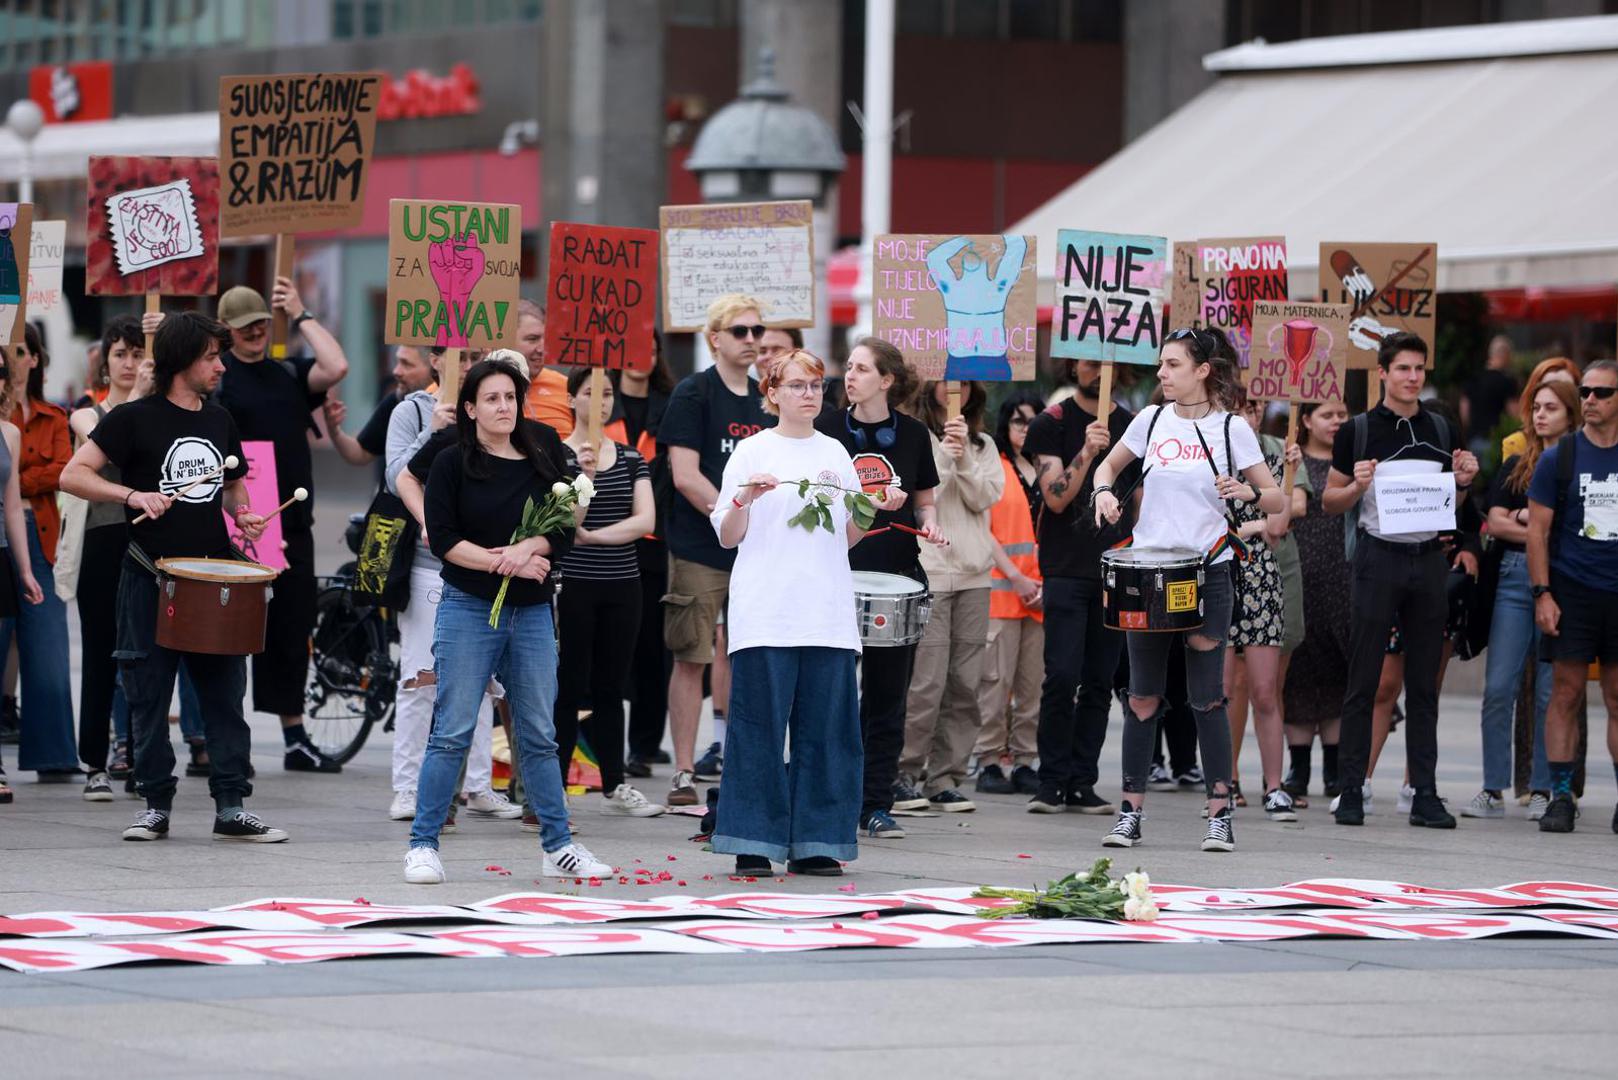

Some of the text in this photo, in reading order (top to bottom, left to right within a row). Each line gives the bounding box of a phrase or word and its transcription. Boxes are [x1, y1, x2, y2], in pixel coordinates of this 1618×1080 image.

[230, 74, 377, 125] SUOSJEĆANJE
[120, 197, 180, 238] ZAŠTITA
[403, 205, 509, 244] USTANI
[563, 235, 647, 269] RAĐAT
[878, 239, 931, 262] MOJE
[395, 257, 520, 277] ZA SVOJA
[880, 269, 942, 292] TIJELO
[1064, 243, 1154, 296] NIJE
[555, 267, 643, 308] ĆU KAD
[1205, 273, 1288, 302] SIGURAN
[396, 299, 509, 340] PRAVA!
[585, 306, 628, 336] AKO
[877, 297, 916, 320] NIJE
[1060, 295, 1158, 349] FAZA
[1205, 303, 1252, 328] POBA
[1255, 304, 1279, 318] MOJA
[179, 458, 206, 469] DRUM
[188, 466, 215, 477] BIJES
[864, 472, 886, 480] BIJES
